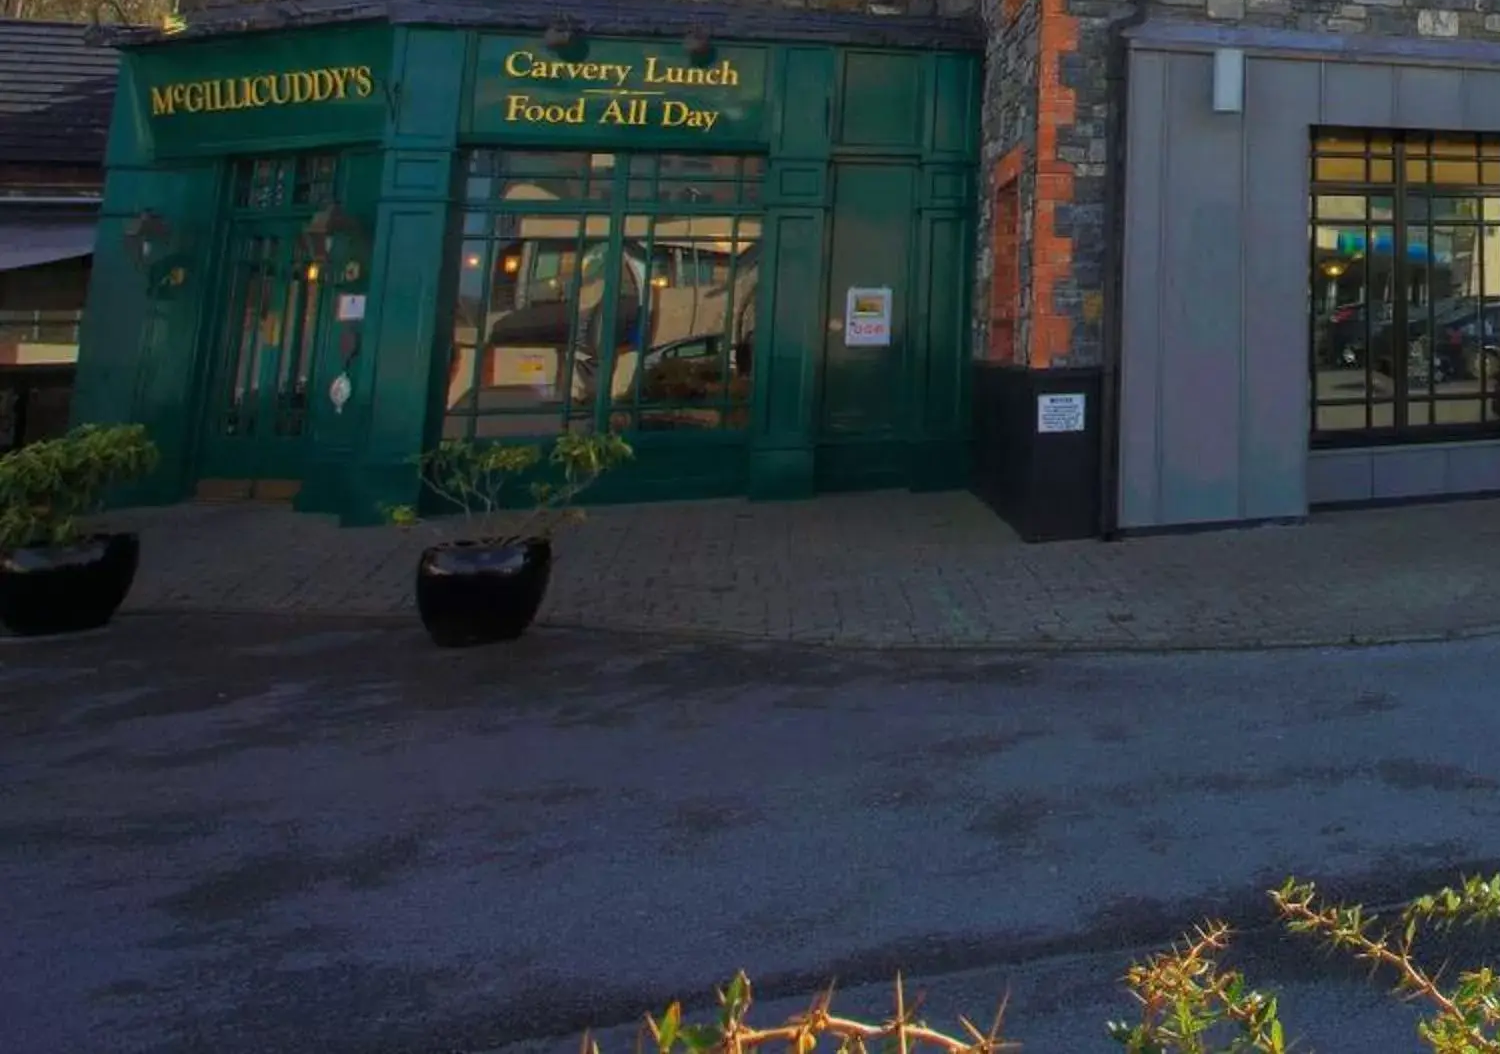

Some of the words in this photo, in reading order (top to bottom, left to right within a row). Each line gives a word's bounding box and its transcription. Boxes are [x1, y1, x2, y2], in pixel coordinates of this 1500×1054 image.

[505, 51, 633, 87] Carvery
[643, 56, 739, 86] Lunch
[151, 65, 373, 116] McGILLICUDDY'S
[505, 95, 586, 124] Food
[598, 98, 649, 125] All
[661, 100, 720, 133] Day
